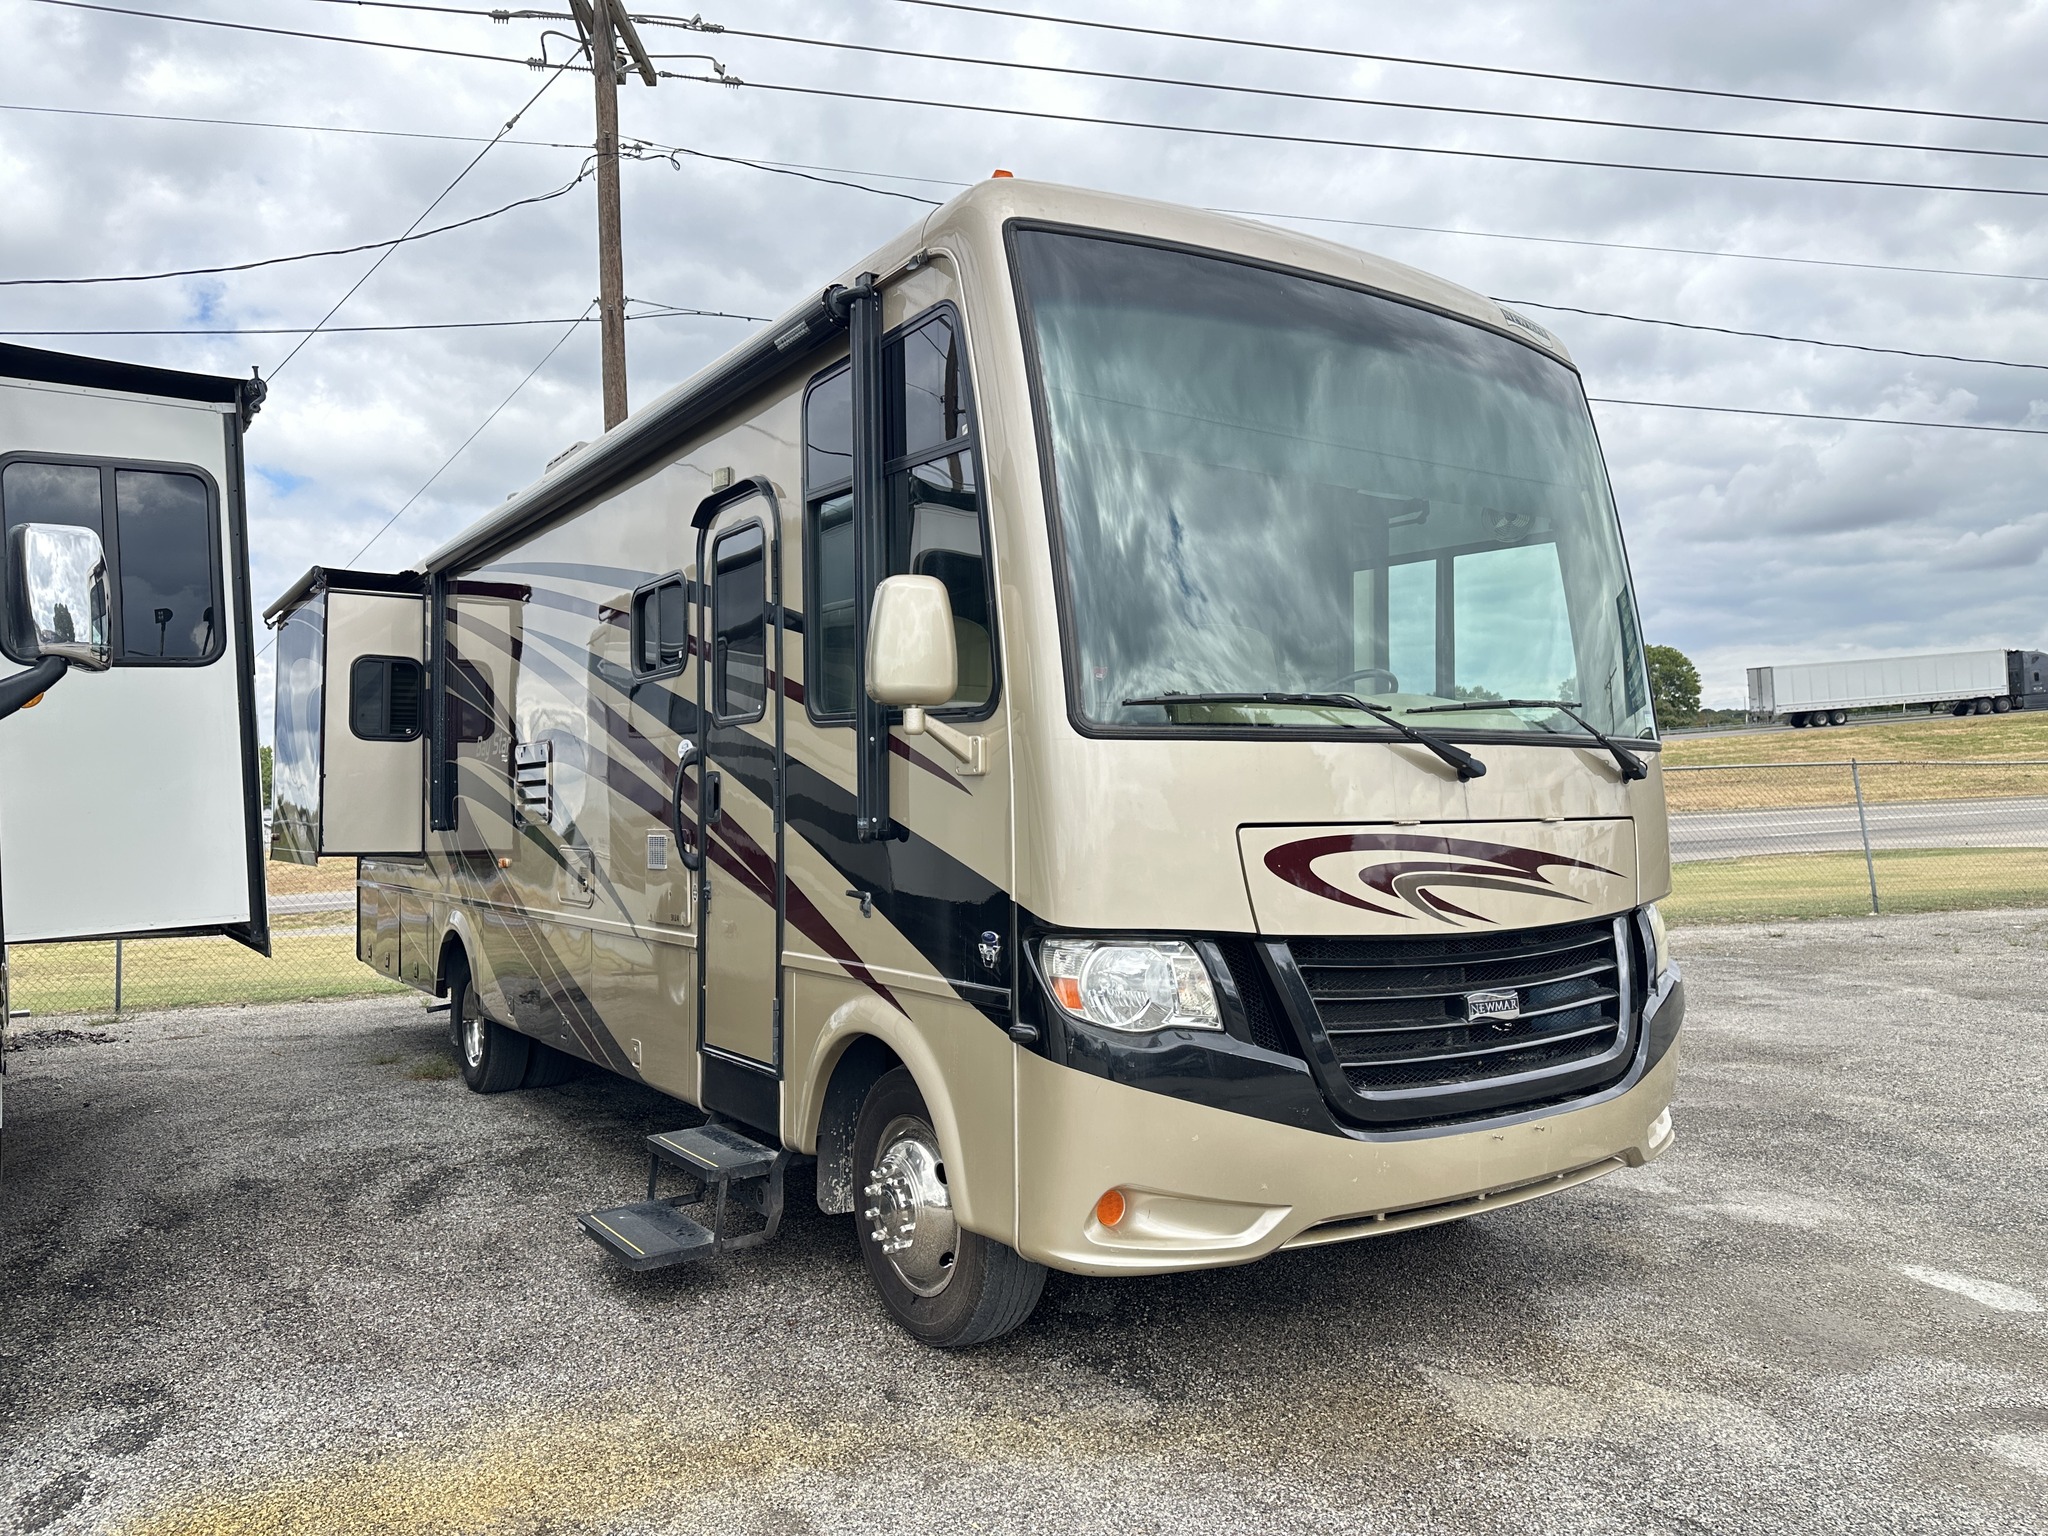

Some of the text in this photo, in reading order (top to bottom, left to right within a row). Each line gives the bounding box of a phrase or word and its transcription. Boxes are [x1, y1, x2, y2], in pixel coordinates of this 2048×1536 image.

[476, 733, 511, 761] Bay Star
[1471, 1000, 1518, 1015] NEWMAR
